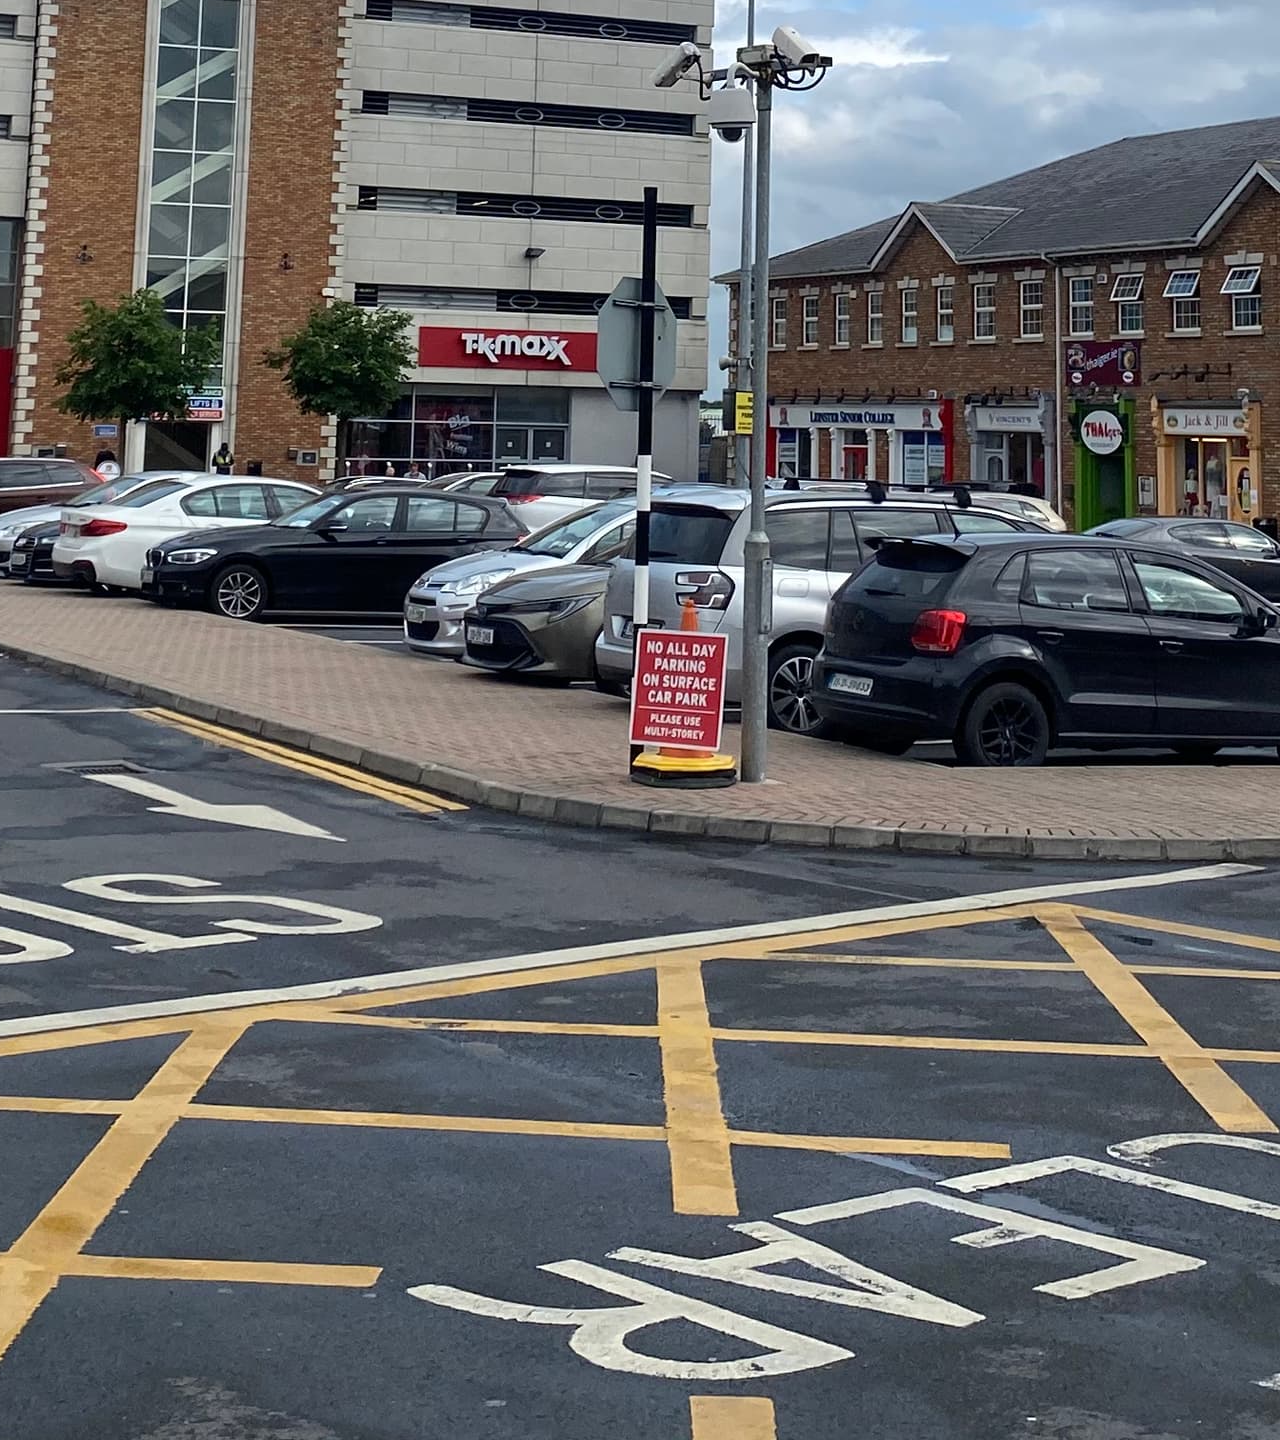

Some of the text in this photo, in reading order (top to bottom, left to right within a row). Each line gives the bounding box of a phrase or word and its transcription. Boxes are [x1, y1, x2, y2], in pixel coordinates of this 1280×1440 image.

[840, 411, 864, 424] SENIOR
[864, 411, 895, 424] COLLEGE
[1183, 414, 1229, 430] Jack & Jill
[646, 640, 717, 657] NO ALL DAY
[654, 657, 706, 673] PARKING
[643, 673, 717, 691] ON SURFACE
[648, 690, 707, 707] CAR PARK
[650, 713, 701, 727] PLEASE USE
[644, 726, 705, 741] MULTI-STOREY
